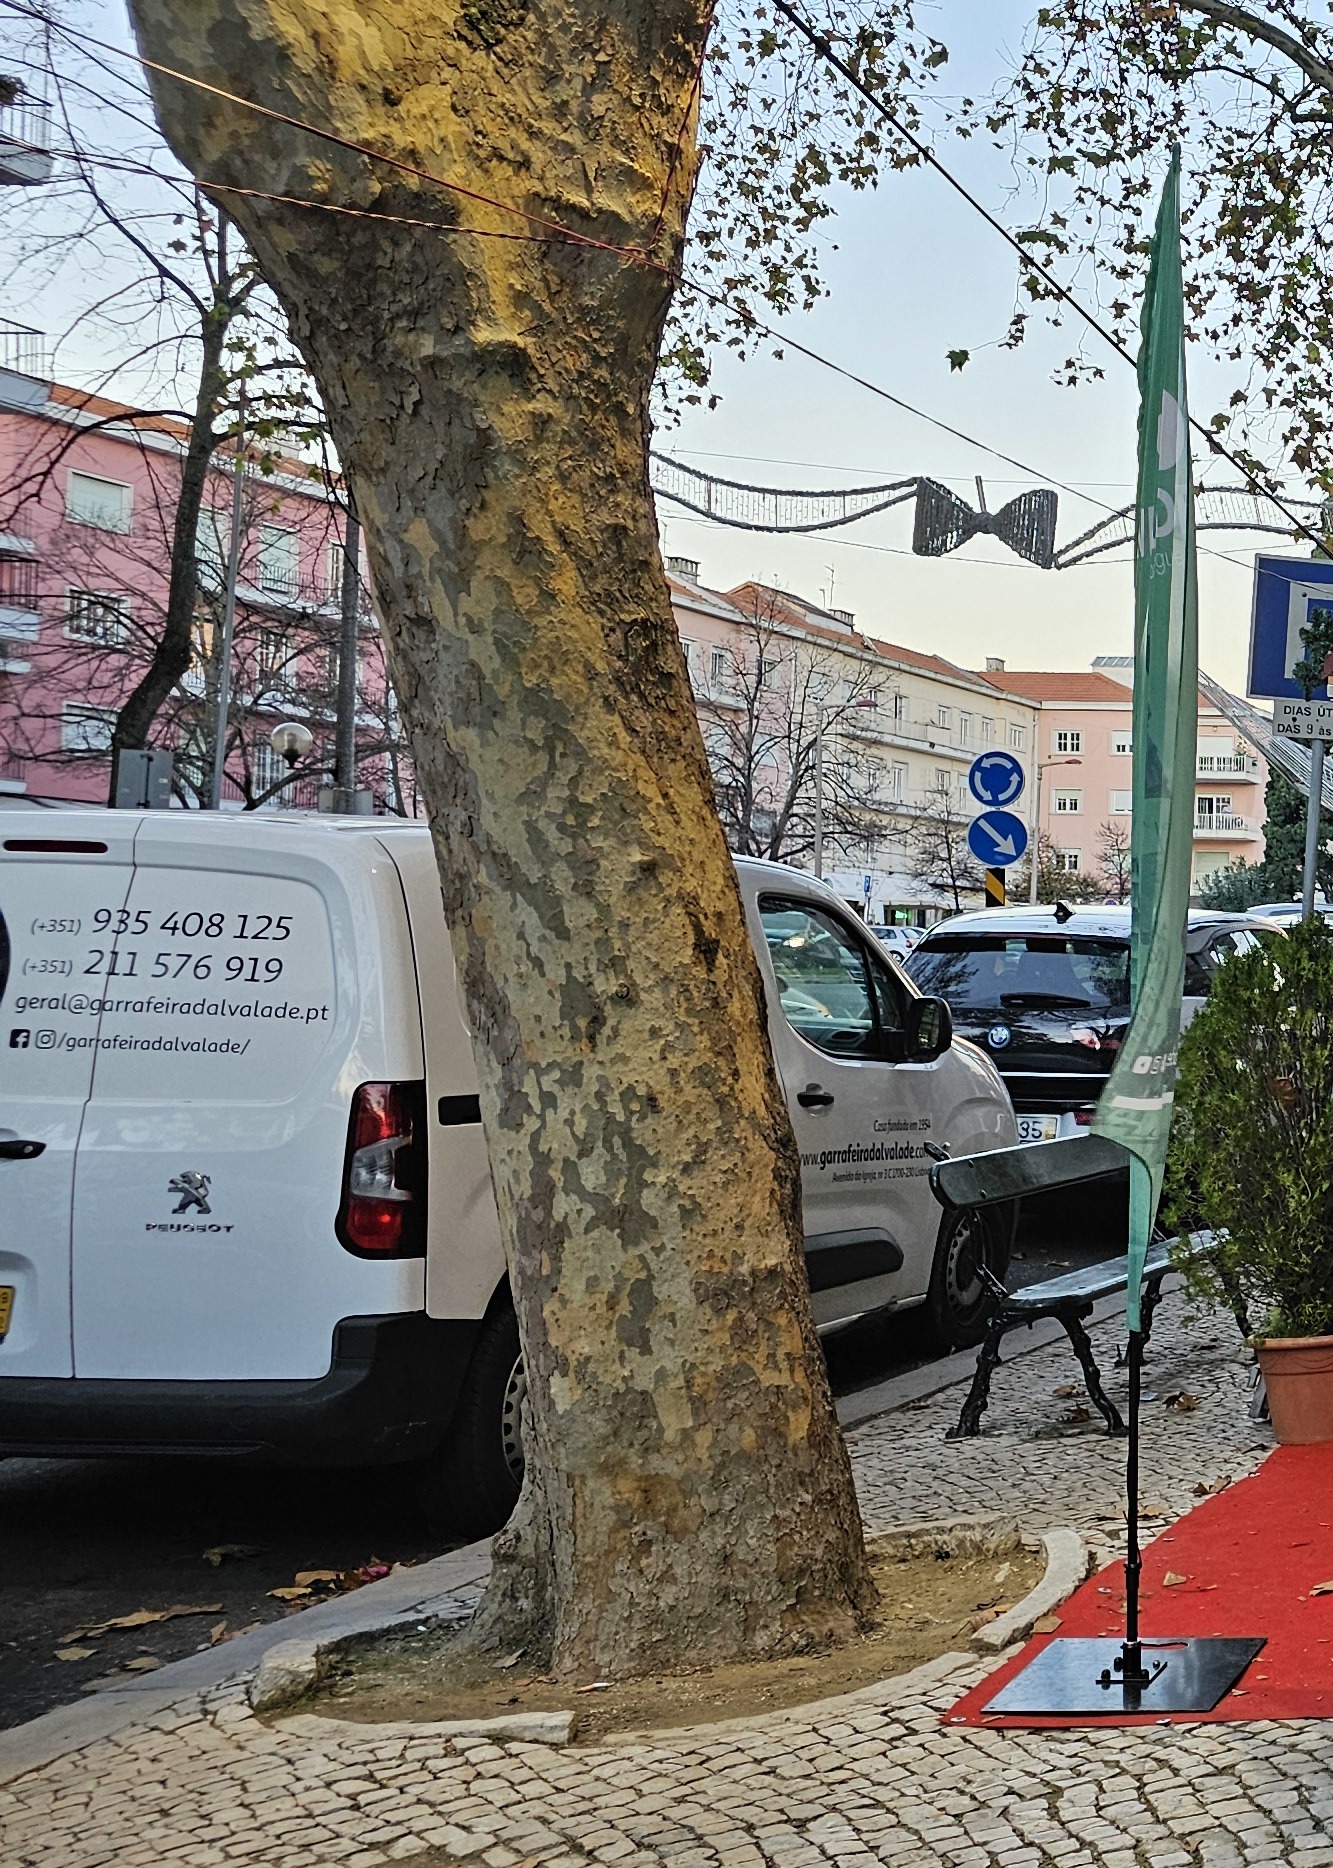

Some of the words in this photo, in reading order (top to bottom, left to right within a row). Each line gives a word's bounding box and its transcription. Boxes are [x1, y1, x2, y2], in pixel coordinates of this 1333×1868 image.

[1284, 705, 1311, 716] DIAS
[1277, 724, 1300, 734] DAS
[1306, 724, 1313, 735] 9
[1319, 726, 1331, 736] às
[30, 918, 82, 937] (+351)
[92, 908, 152, 936] 935
[160, 910, 225, 938] 408
[233, 914, 294, 941] 125
[22, 957, 73, 977] (+351)
[83, 949, 139, 978] 211
[151, 952, 212, 981] 576
[224, 956, 284, 984] 919
[15, 993, 329, 1024] geral@garrafeiradalvalade.pt
[1020, 1121, 1043, 1139] 35
[145, 1223, 235, 1233] PEUGEOT
